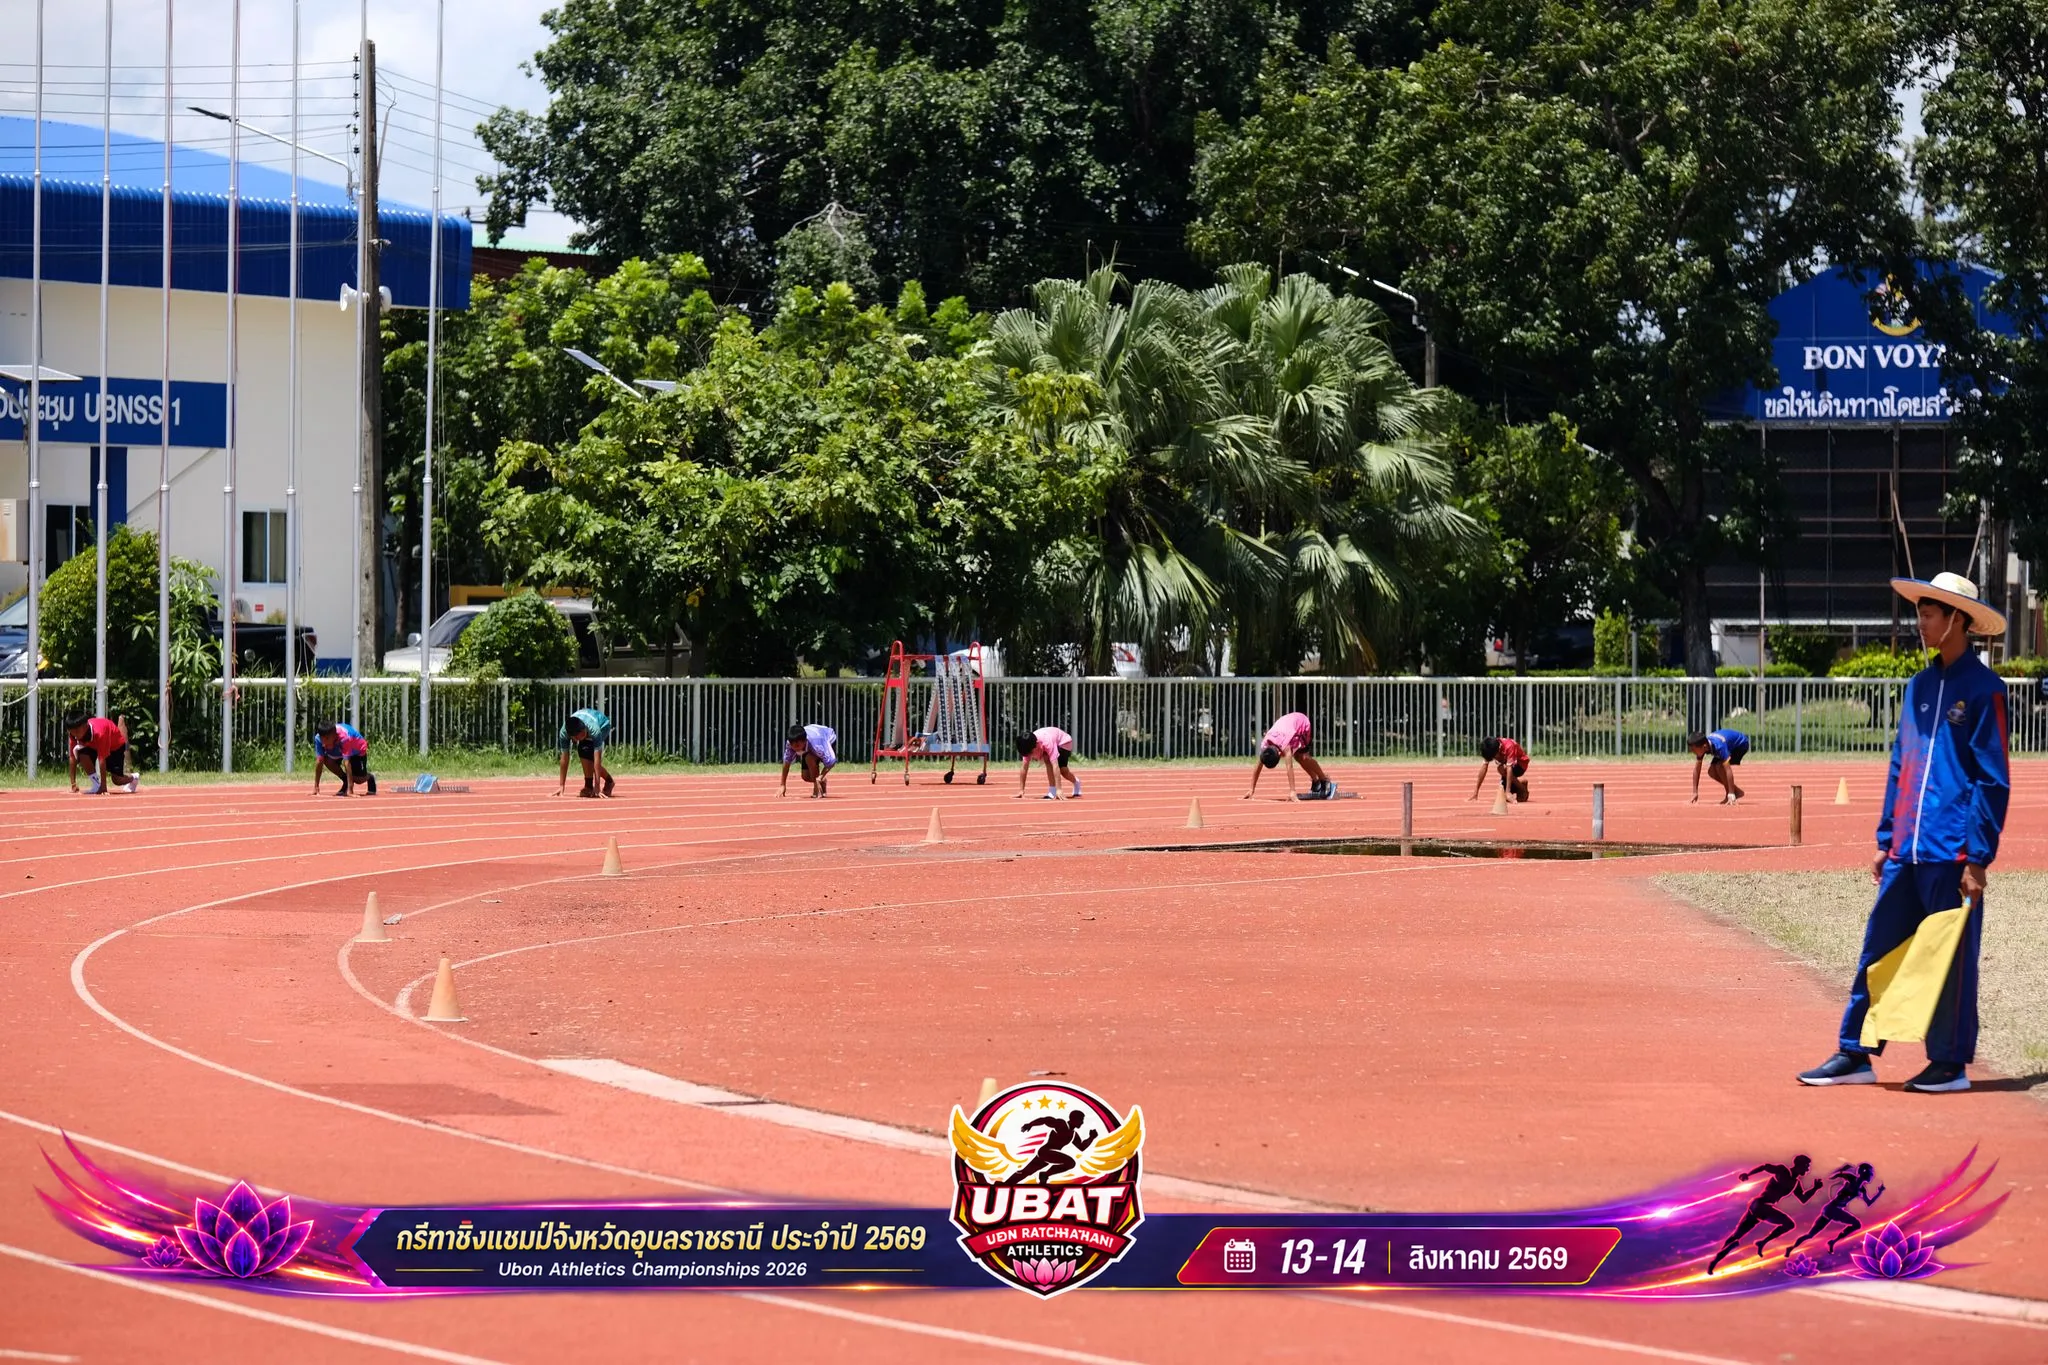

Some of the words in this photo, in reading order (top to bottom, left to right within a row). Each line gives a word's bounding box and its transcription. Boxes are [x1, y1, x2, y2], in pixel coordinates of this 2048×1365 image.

[1803, 345, 1867, 370] BON
[85, 393, 163, 425] UBNSS
[171, 397, 181, 426] 1
